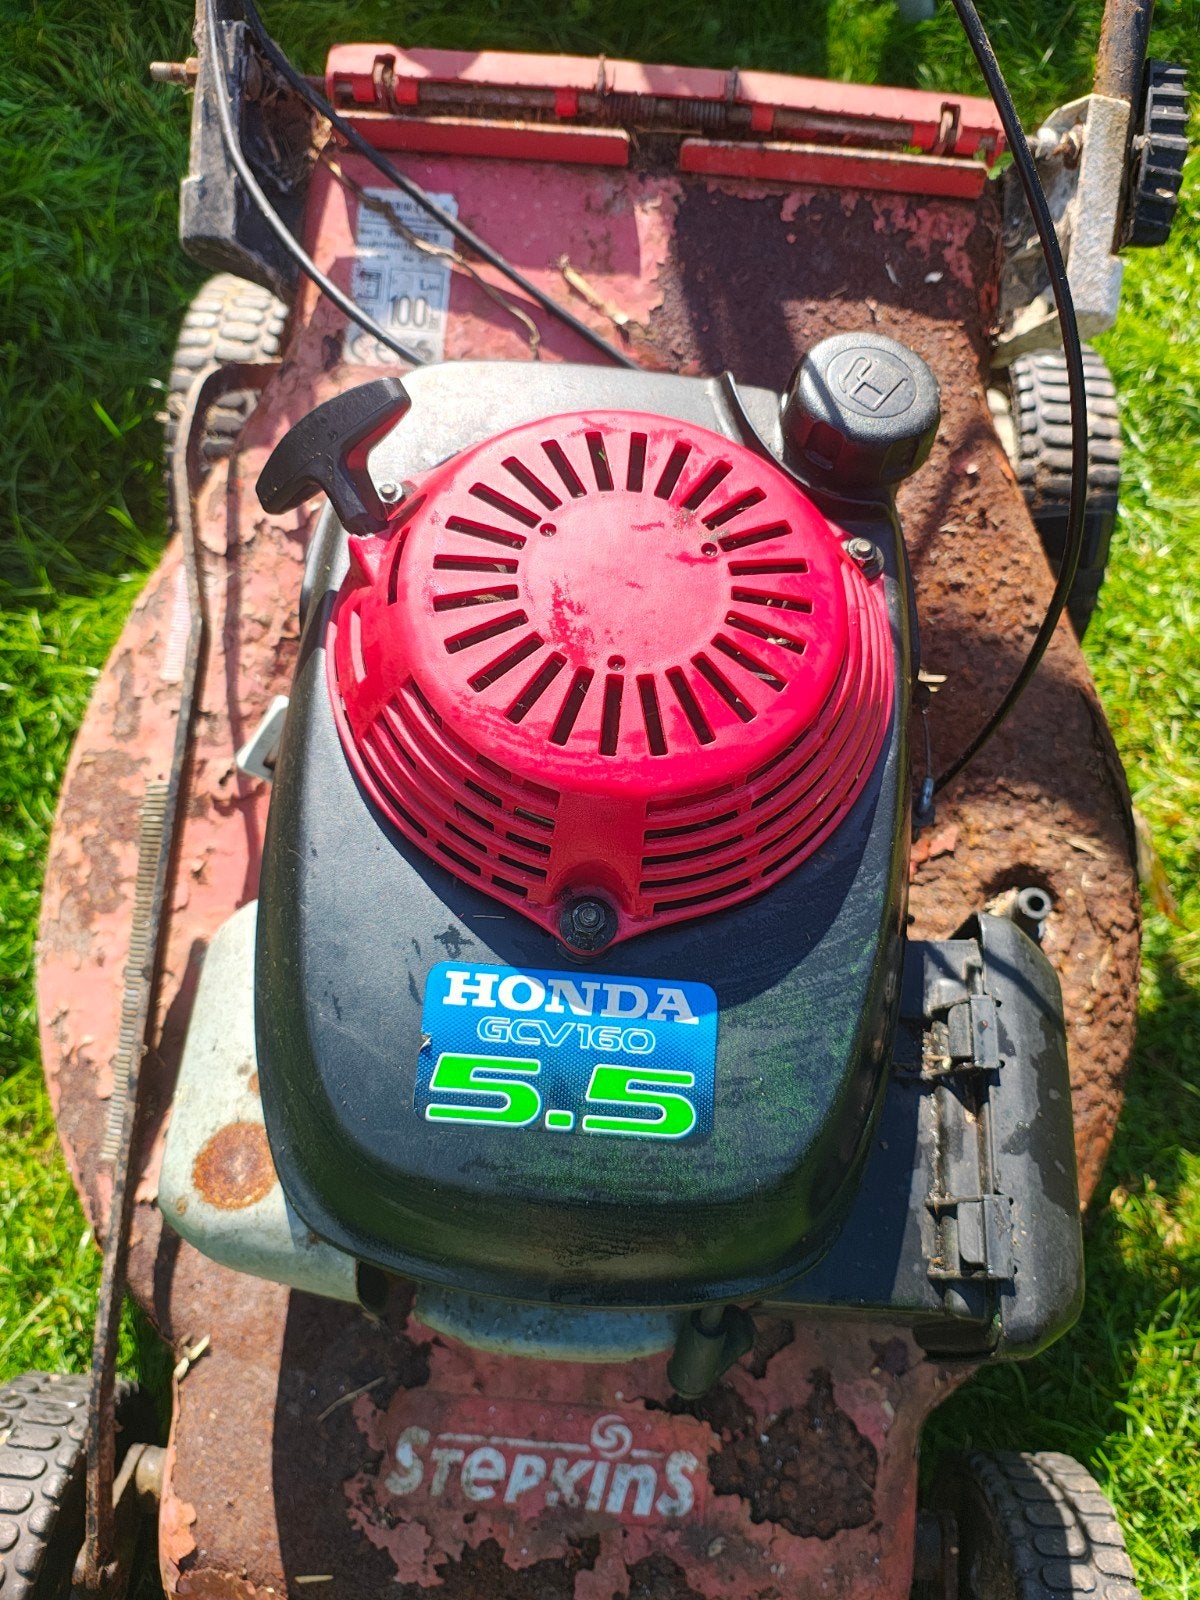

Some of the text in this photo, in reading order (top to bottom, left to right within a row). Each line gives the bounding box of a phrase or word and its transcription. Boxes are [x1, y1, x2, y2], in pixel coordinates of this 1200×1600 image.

[390, 295, 426, 327] 100
[442, 970, 699, 1025] HONDA
[477, 1016, 656, 1054] GCV160
[426, 1052, 696, 1139] 5.5
